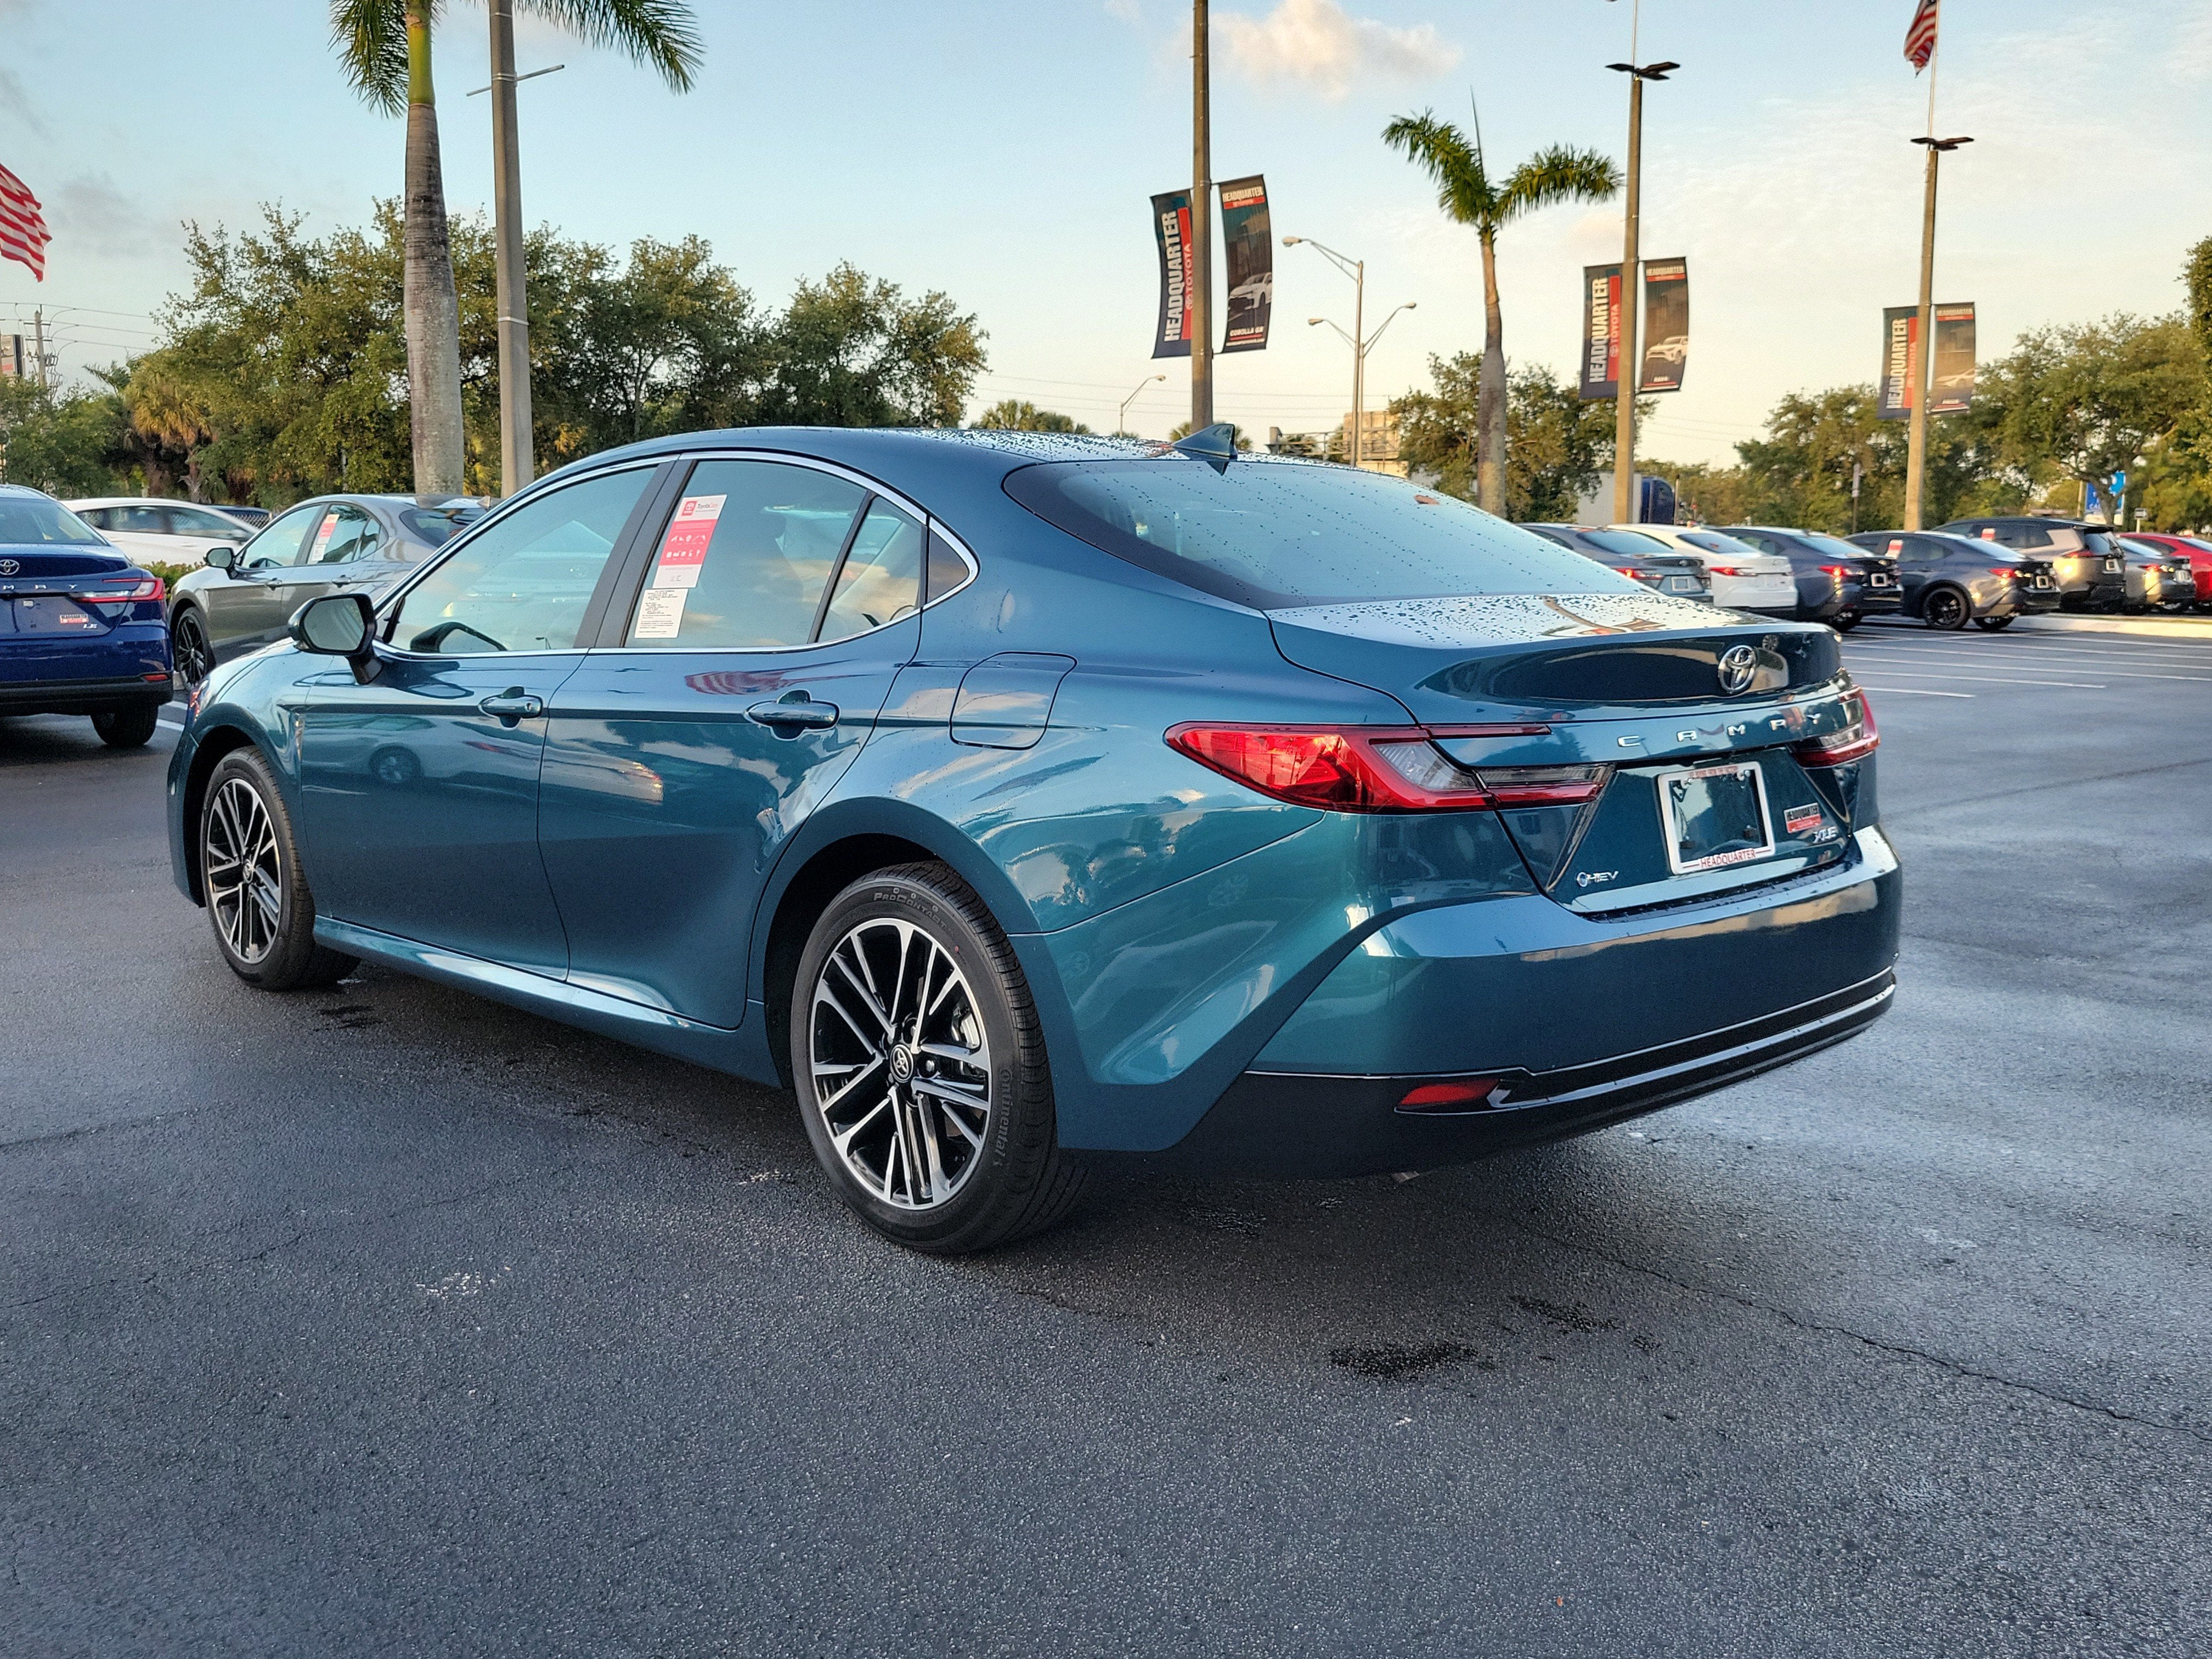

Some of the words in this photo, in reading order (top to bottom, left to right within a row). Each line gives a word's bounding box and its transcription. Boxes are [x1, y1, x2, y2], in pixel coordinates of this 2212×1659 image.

[1161, 210, 1183, 342] HEADQUARTER
[1589, 277, 1610, 383] HEADQUARTER
[1886, 318, 1908, 409] HEADQUARTER
[1617, 713, 1821, 747] CAMRY
[1701, 849, 1756, 868] HEADQUARTER
[1812, 826, 1839, 844] XLE
